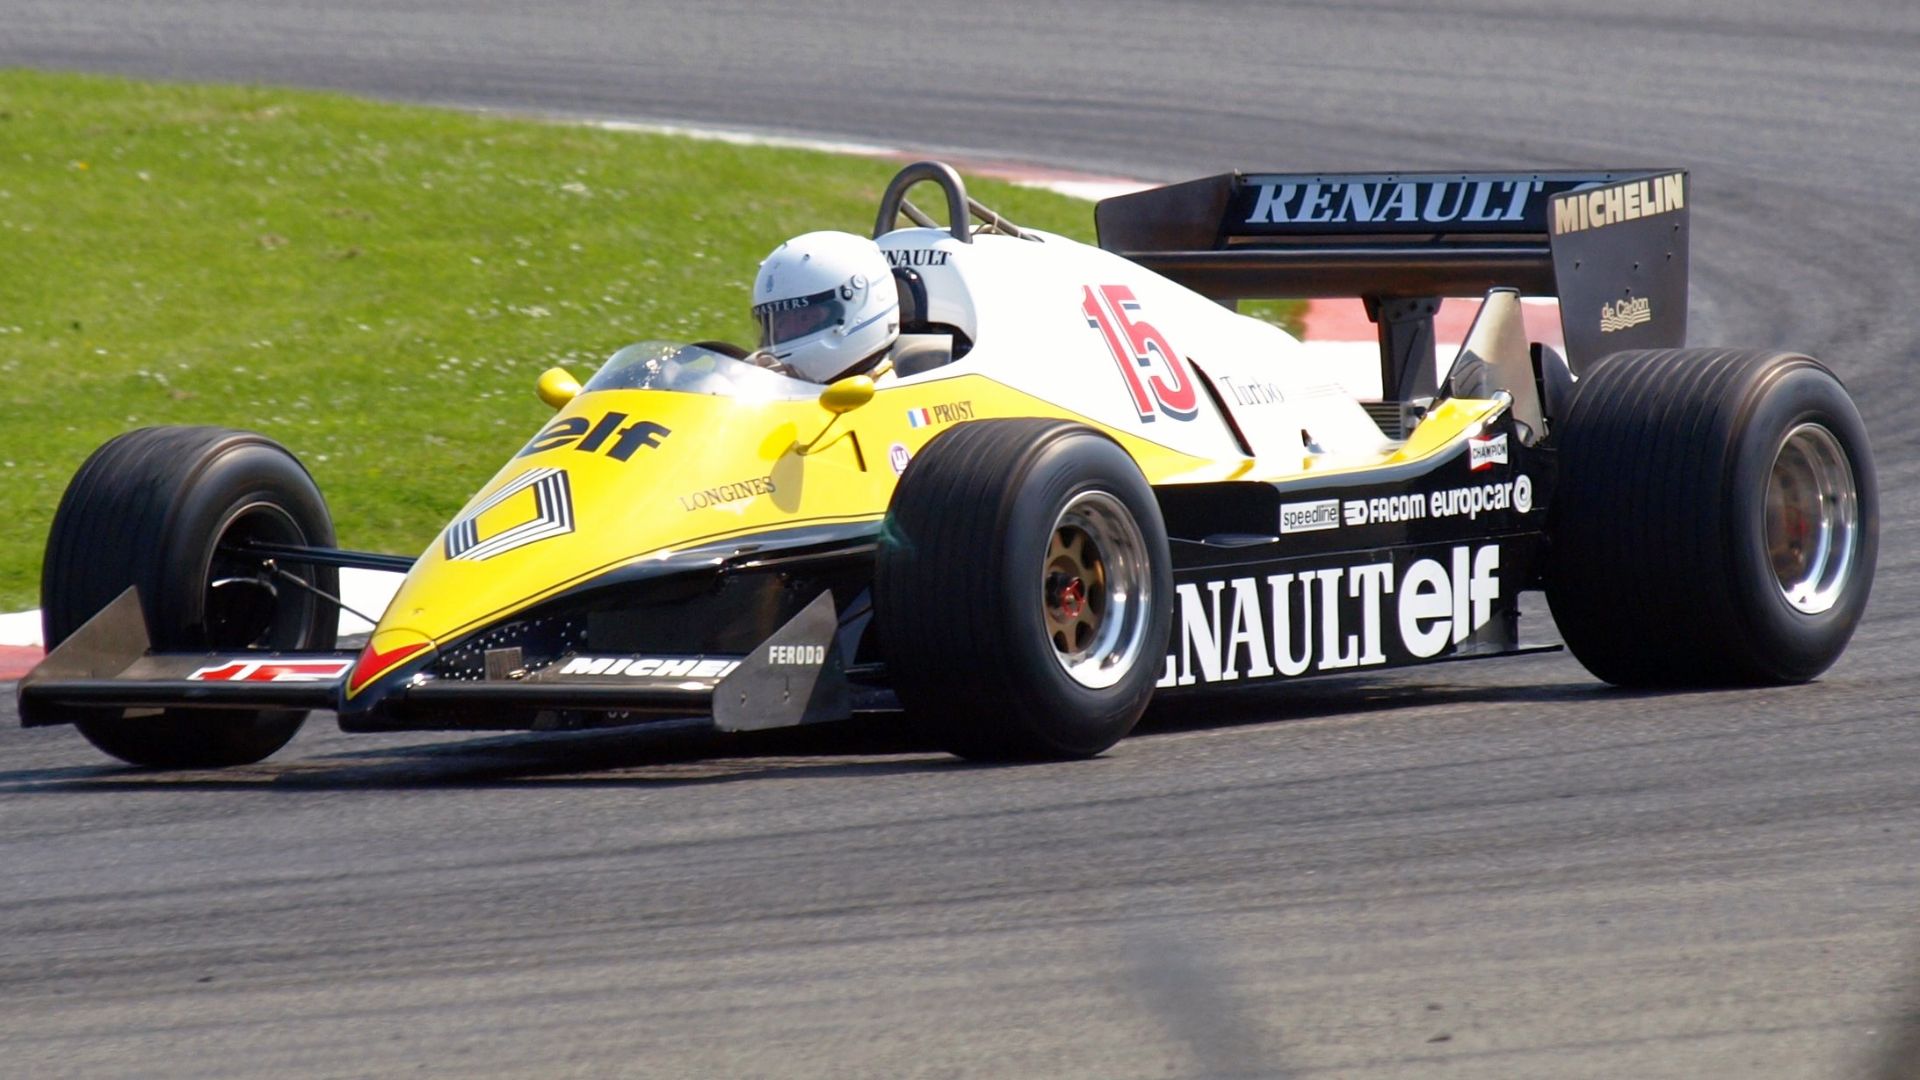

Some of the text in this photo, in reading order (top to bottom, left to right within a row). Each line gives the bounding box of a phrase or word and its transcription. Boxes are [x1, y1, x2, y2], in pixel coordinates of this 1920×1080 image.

[1245, 181, 1545, 223] RENAULT
[1554, 173, 1684, 235] MICHELIN
[880, 249, 952, 266] NAULT
[1602, 301, 1614, 319] de
[1081, 284, 1198, 424] 15
[1219, 376, 1284, 406] Turbo
[933, 400, 974, 424] PROST
[516, 411, 672, 463] elf
[1472, 443, 1507, 459] CHAMPION
[680, 475, 776, 512] LONGINES
[1283, 482, 1513, 529] speedline FACOM europcar
[1156, 545, 1500, 688] NAULT elf
[769, 646, 824, 664] FERODO
